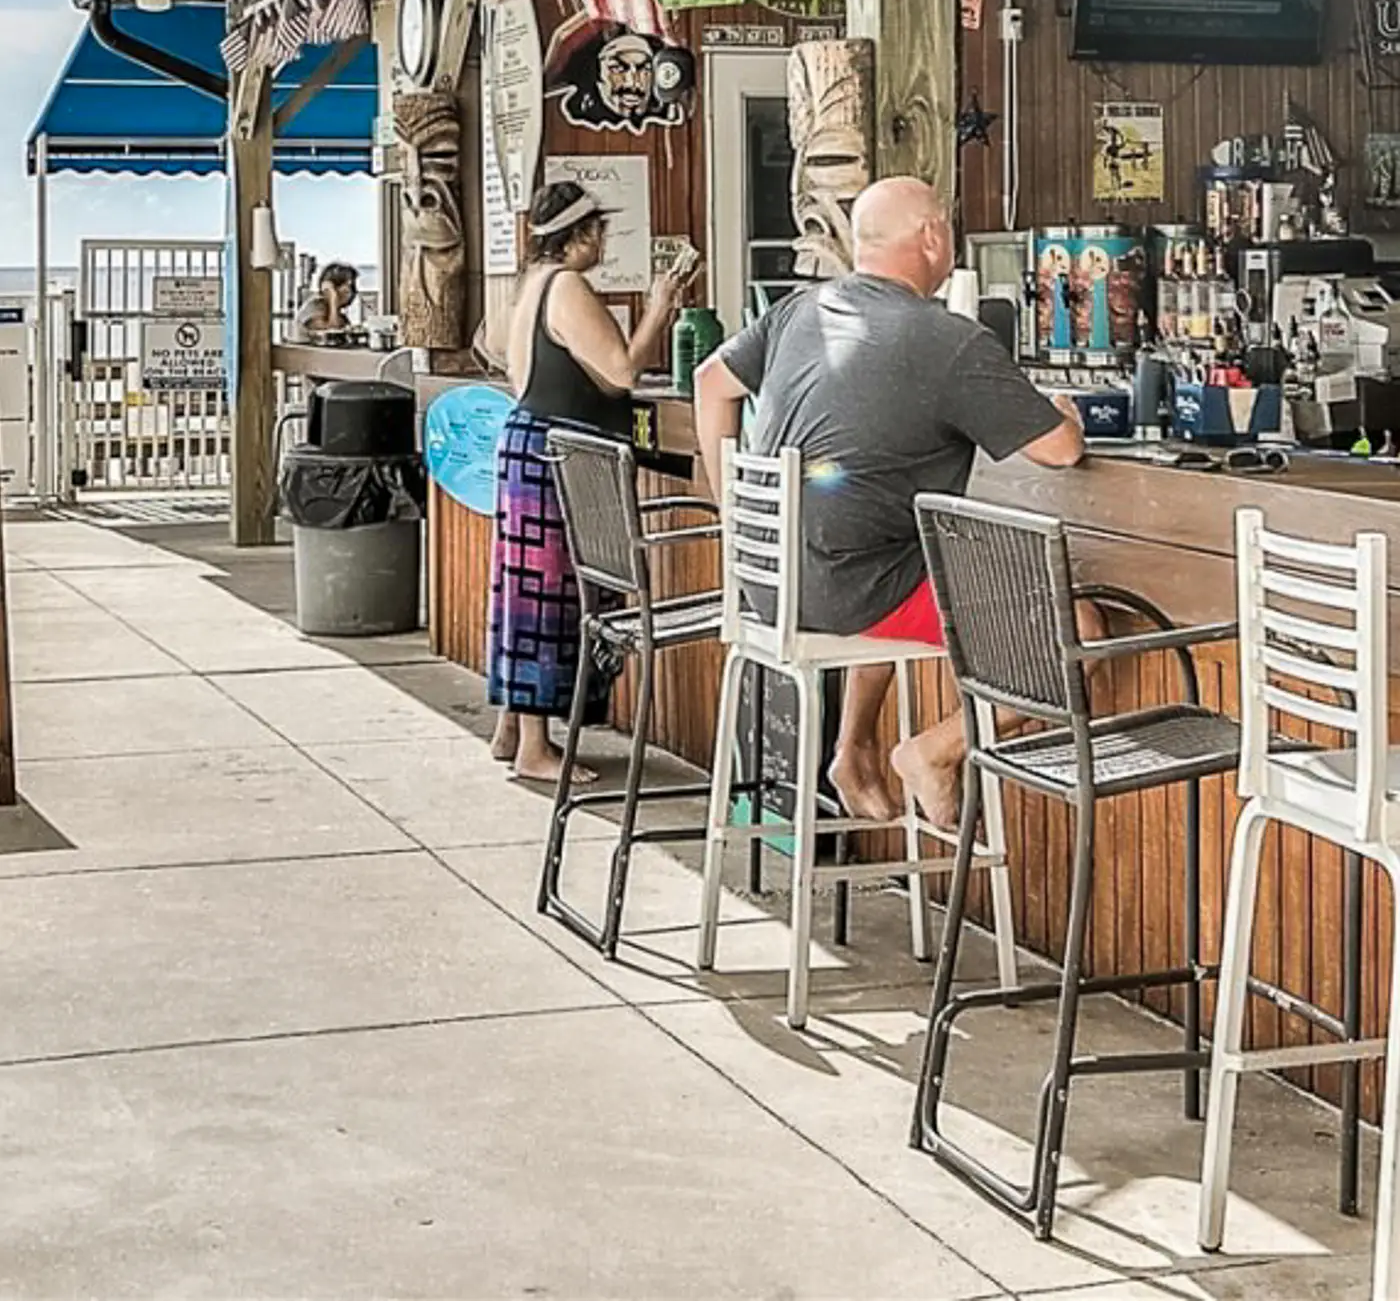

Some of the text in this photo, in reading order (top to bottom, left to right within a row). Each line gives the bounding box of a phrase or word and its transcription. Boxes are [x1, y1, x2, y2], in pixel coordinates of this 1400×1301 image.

[151, 349, 224, 358] NO PETS ARE
[161, 359, 216, 367] ALLOWED
[144, 367, 165, 376] ON
[169, 367, 189, 376] THE
